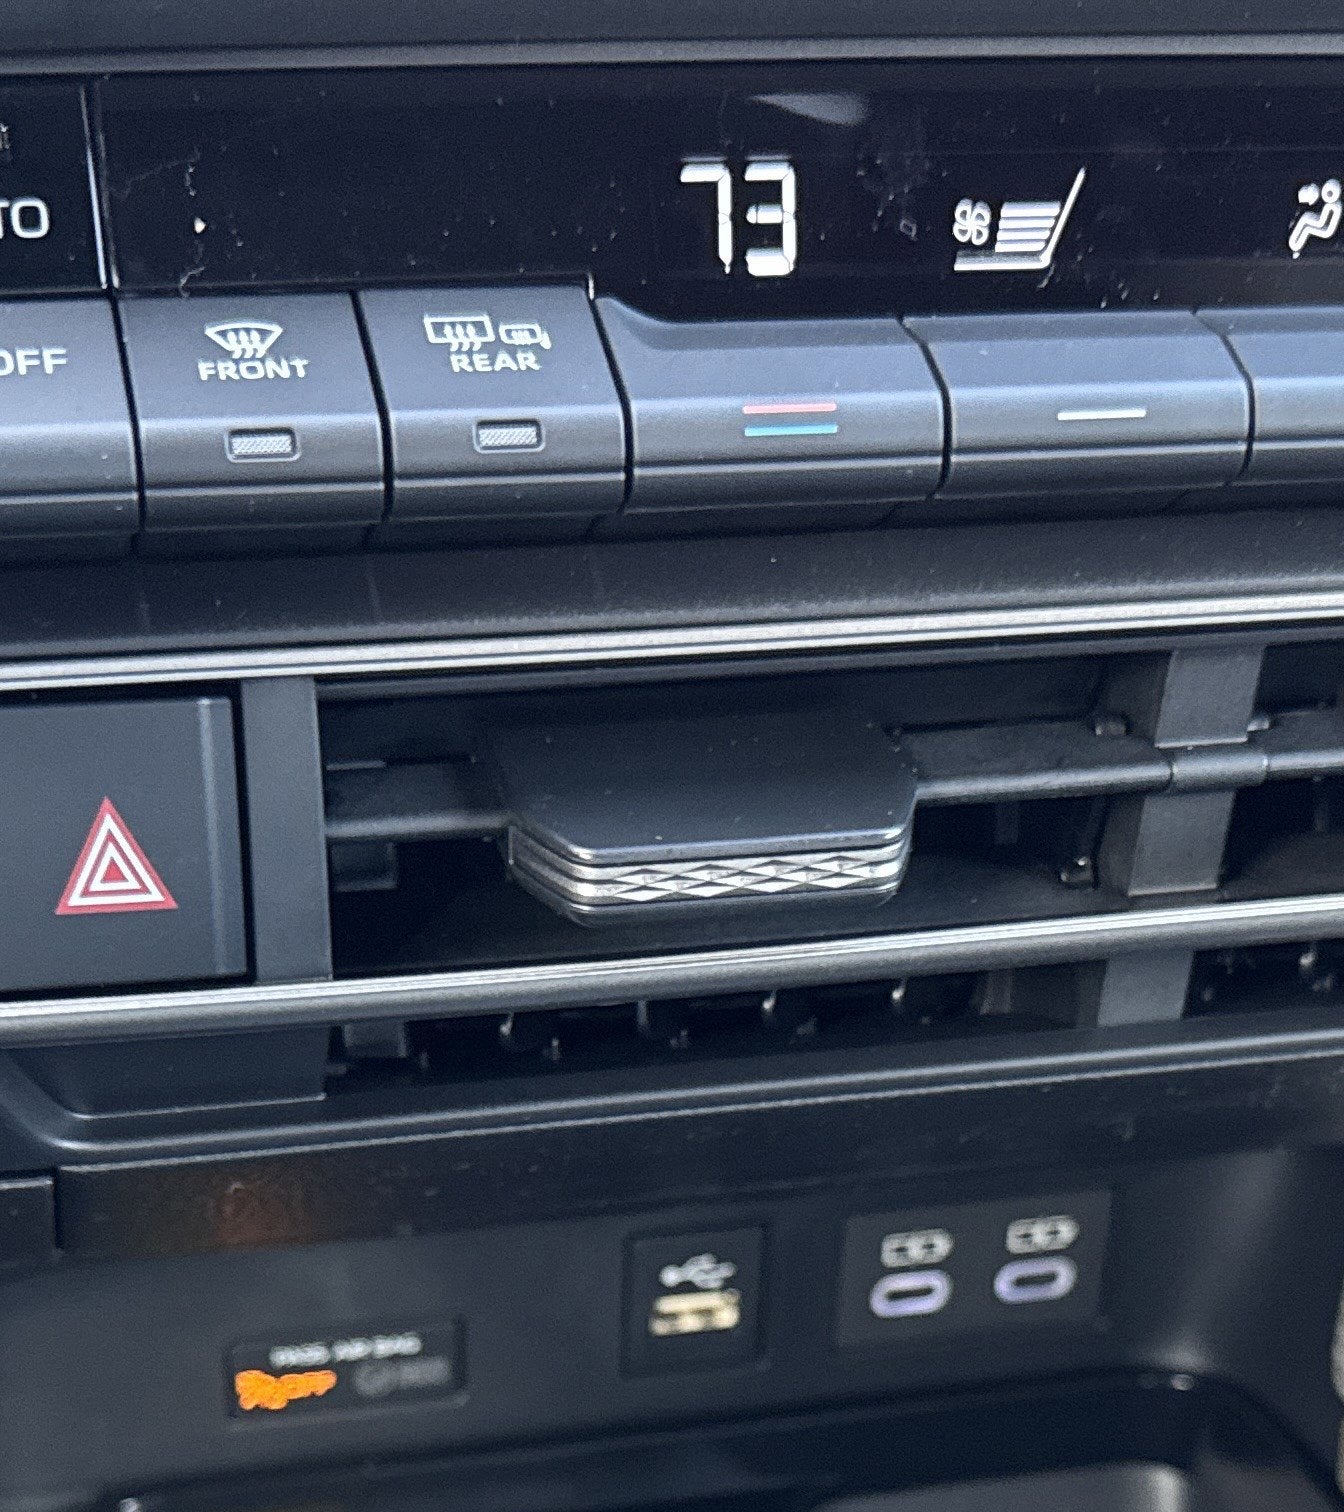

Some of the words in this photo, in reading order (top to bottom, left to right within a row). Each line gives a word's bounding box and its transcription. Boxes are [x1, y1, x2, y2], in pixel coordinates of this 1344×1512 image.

[679, 162, 797, 277] 73
[197, 357, 310, 382] FRONT
[449, 350, 543, 374] REAR
